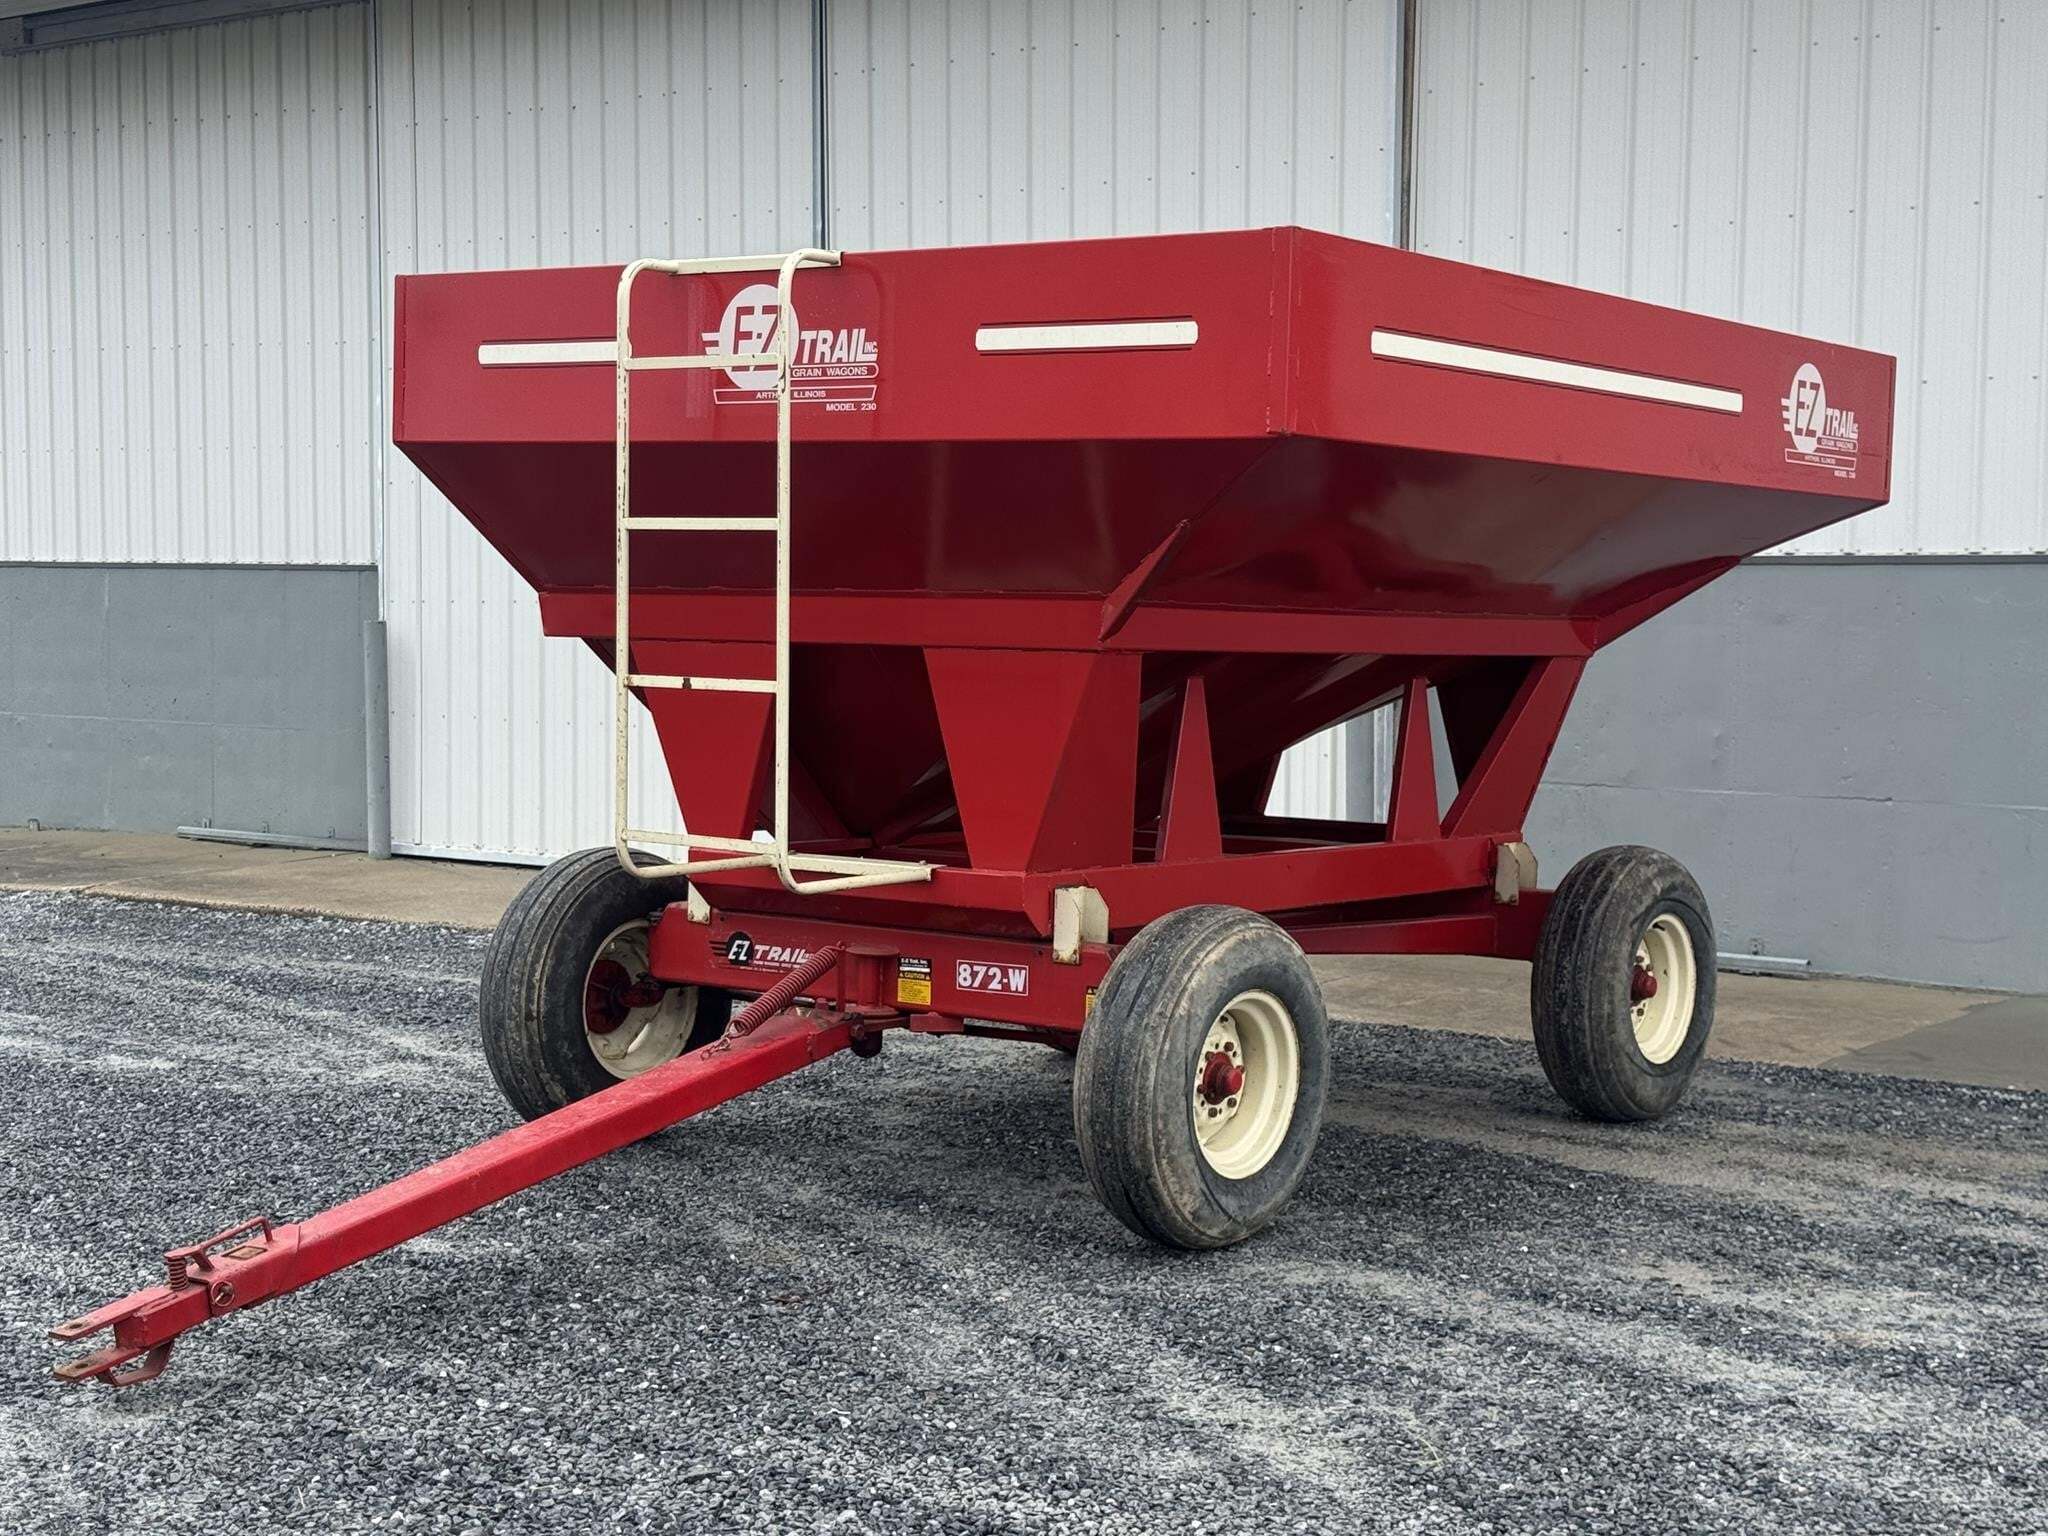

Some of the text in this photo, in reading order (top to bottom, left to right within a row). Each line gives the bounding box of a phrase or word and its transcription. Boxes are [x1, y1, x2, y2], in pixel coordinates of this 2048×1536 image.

[800, 328, 878, 363] TRAIL
[792, 366, 868, 377] GRAIN WAGONS
[756, 391, 779, 399] ARTH
[826, 402, 877, 411] MODEL 230
[1825, 407, 1858, 439] TRAIL
[753, 944, 809, 964] TRAIL
[958, 963, 1026, 992] 872-W
